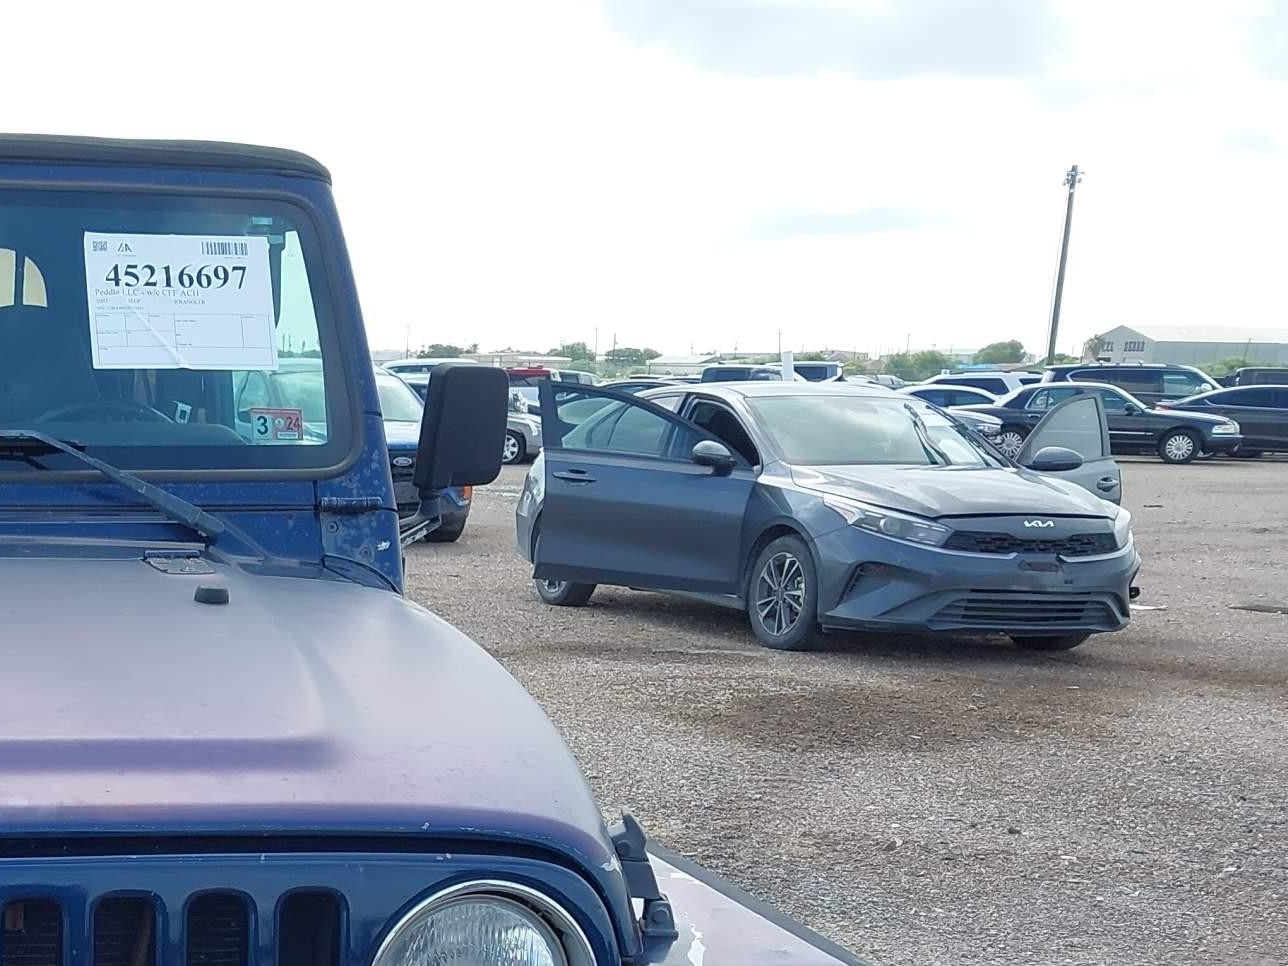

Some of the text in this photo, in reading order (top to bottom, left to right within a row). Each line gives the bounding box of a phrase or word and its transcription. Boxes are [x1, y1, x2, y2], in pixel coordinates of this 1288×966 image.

[105, 263, 247, 290] 45216697
[95, 288, 120, 296] Peddle
[121, 288, 138, 296] LLC
[257, 416, 300, 435] 3 24
